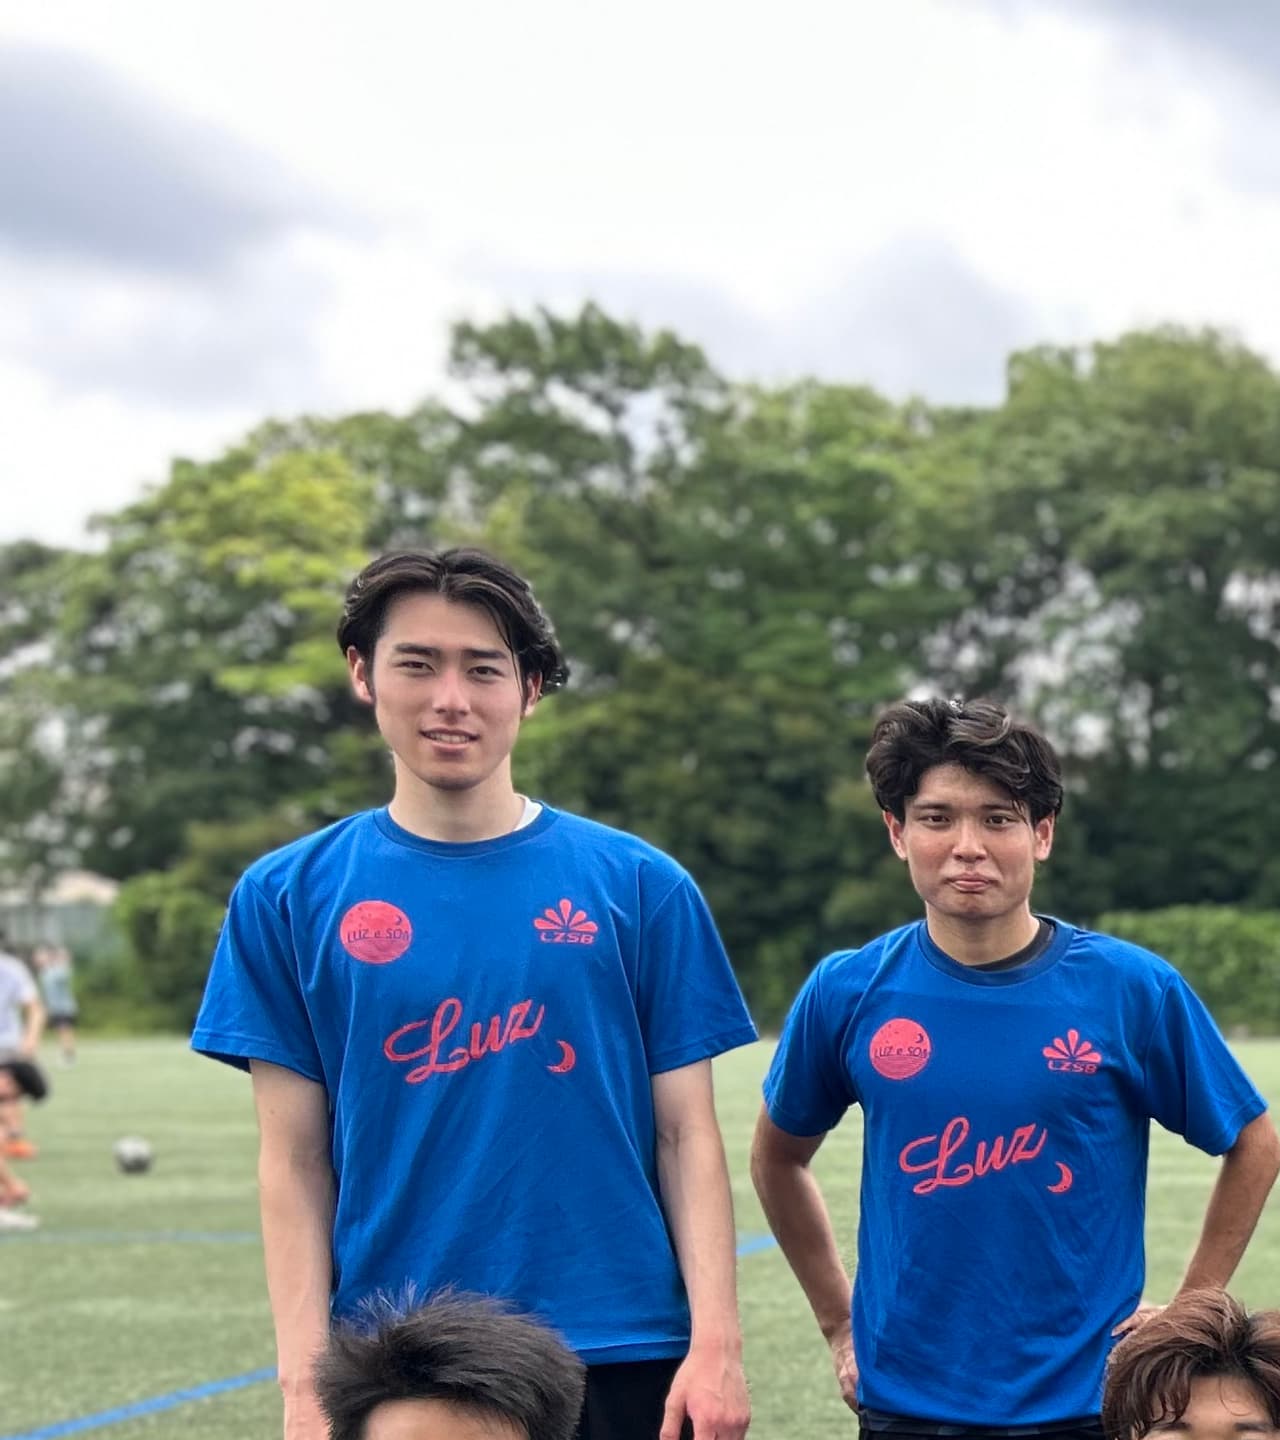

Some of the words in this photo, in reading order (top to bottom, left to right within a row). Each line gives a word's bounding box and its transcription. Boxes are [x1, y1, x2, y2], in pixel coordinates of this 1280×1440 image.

[540, 932, 594, 944] LZSB
[383, 998, 545, 1085] Luz
[1048, 1060, 1098, 1074] LZSB
[898, 1117, 1047, 1195] Luz
